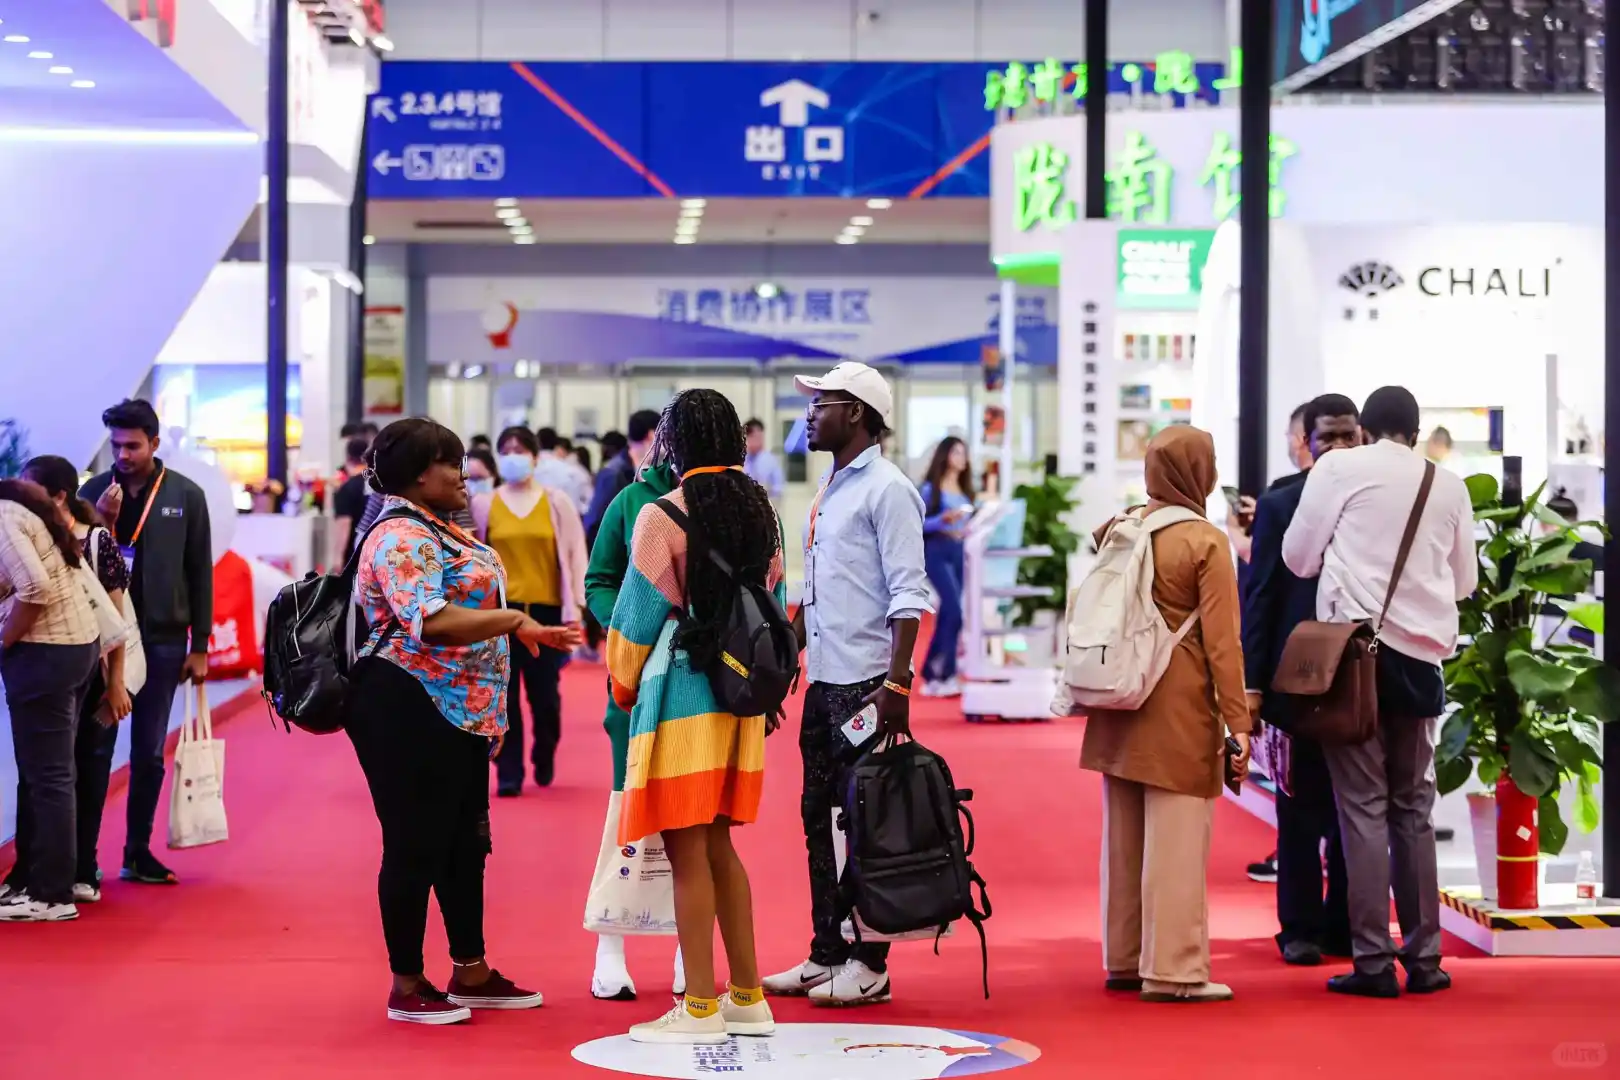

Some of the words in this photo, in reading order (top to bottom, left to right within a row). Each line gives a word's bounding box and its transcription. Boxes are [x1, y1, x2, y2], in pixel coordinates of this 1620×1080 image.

[745, 126, 843, 161] 出口
[762, 164, 821, 181] EXIT
[1418, 267, 1550, 296] CHALI
[732, 991, 753, 1002] VANS
[688, 1001, 708, 1011] VANS
